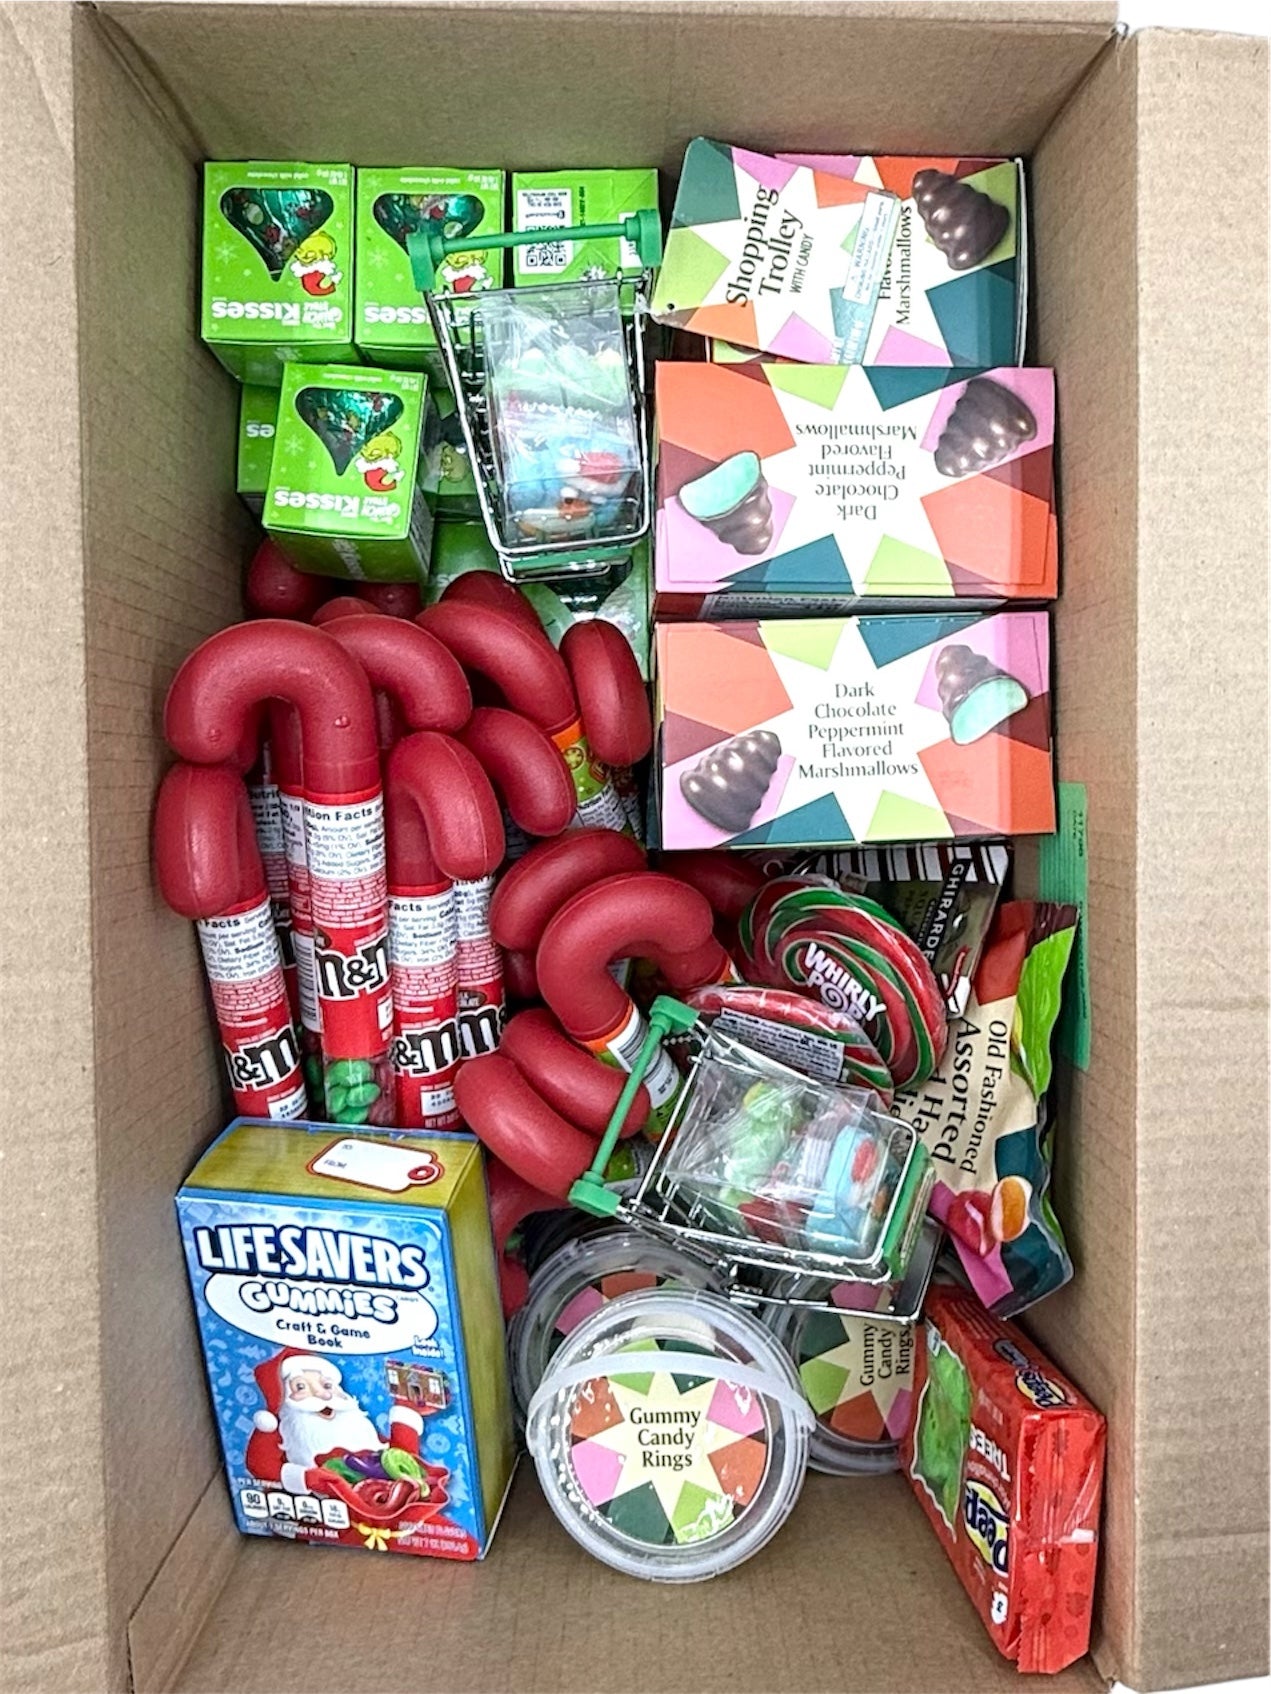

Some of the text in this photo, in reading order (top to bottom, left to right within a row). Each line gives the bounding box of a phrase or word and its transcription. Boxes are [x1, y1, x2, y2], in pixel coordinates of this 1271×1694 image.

[725, 183, 779, 308] Shopping
[758, 208, 804, 296] Trolley
[789, 233, 815, 294] WITH CANDY
[895, 205, 912, 325] Marshmallows
[211, 301, 300, 320] Kisses
[795, 424, 918, 440] Marshmallows
[821, 444, 892, 460] Flavored
[808, 460, 906, 480] Peppermint
[274, 490, 360, 513] Kisses
[814, 484, 899, 500] Chocolate
[836, 504, 877, 521] Dark
[834, 681, 875, 698] Dark
[814, 701, 897, 719] Chocolate
[808, 720, 904, 742] Peppermint
[822, 740, 893, 758] Flavored
[798, 760, 919, 779] Marshmallows
[335, 808, 373, 821] Facts
[924, 863, 964, 961] GHIRARDE
[804, 942, 887, 1021] WHIRLY
[931, 1017, 982, 1165] Assorted
[959, 1019, 1008, 1175] Old Fashioned
[276, 1319, 371, 1340] Craft & Game
[308, 1334, 343, 1349] Book
[895, 1330, 914, 1375] Rings
[860, 1322, 879, 1387] Gummy
[878, 1328, 897, 1379] Candy
[629, 1406, 701, 1428] Gummy
[638, 1427, 695, 1450] Candy
[642, 1450, 693, 1472] Rings
[246, 1492, 261, 1504] 90
[965, 1488, 1010, 1574] Peep
